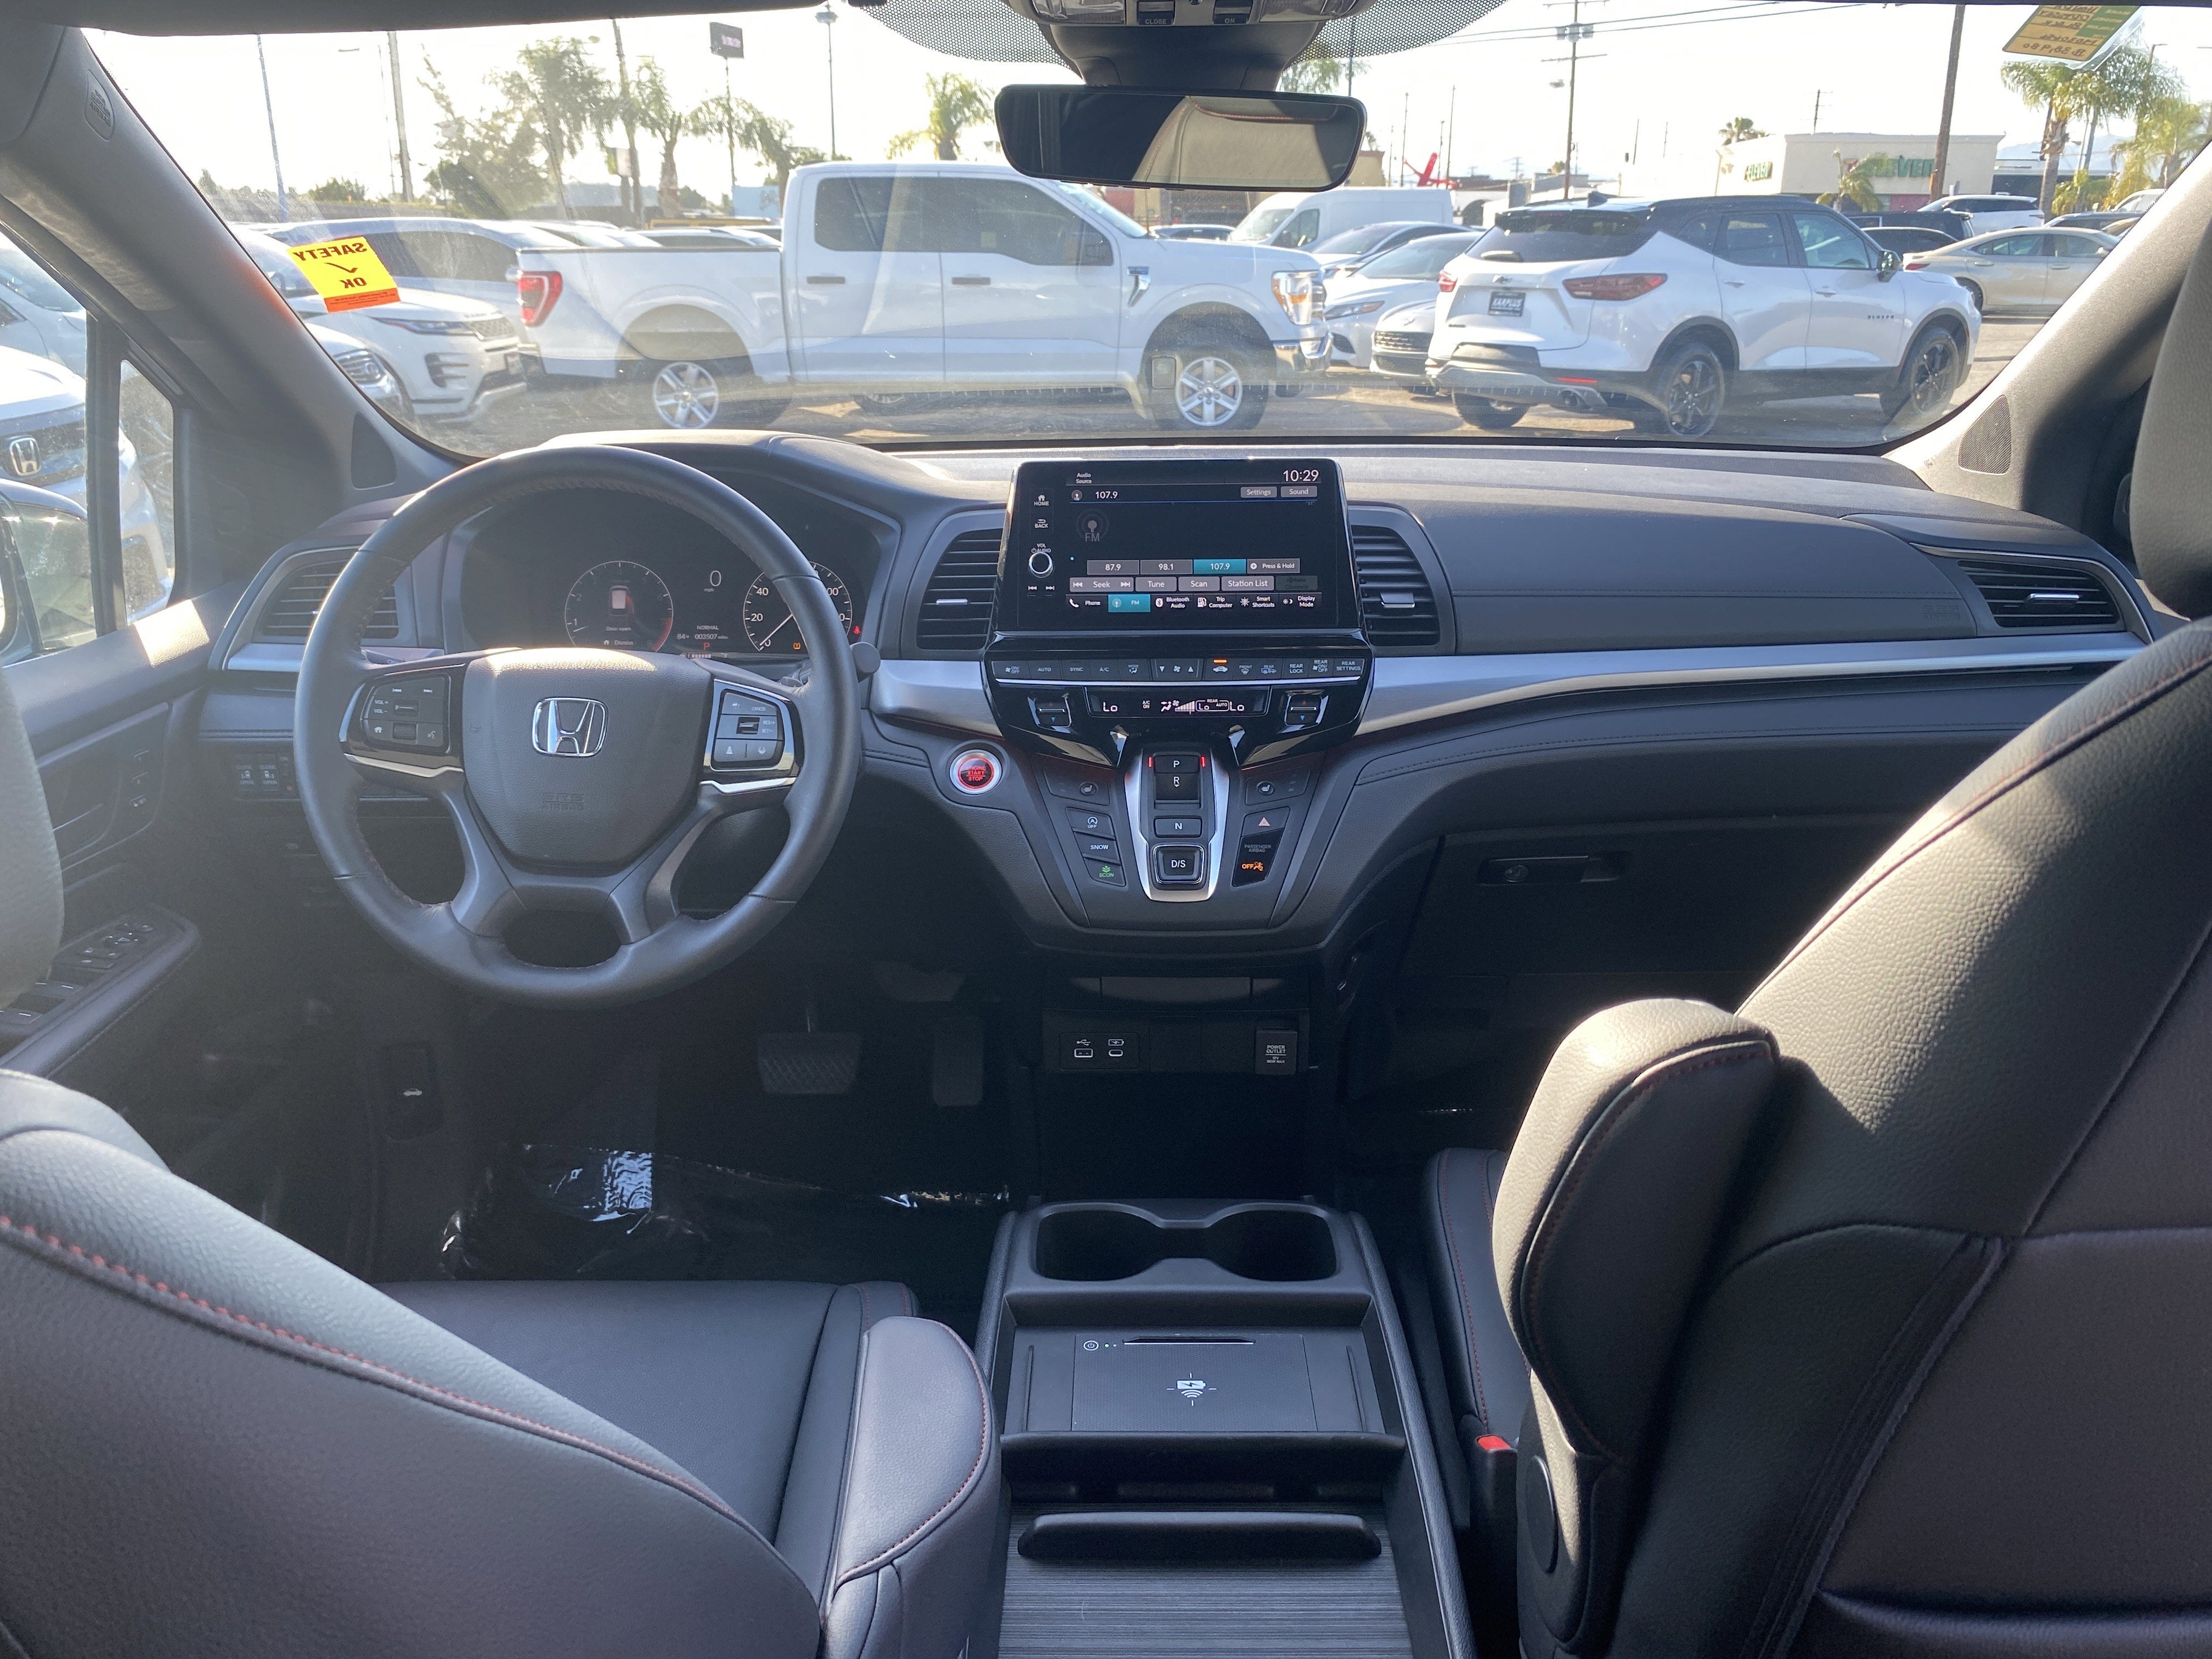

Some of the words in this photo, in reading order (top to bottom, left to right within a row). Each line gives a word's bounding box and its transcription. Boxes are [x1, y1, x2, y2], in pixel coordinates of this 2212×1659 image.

[1283, 469, 1319, 482] 10:29
[1095, 491, 1118, 499] 107.9
[1085, 533, 1101, 542] FM
[709, 569, 722, 587] 0
[756, 587, 769, 596] 40
[825, 588, 839, 596] 00
[751, 613, 763, 622] 20
[704, 642, 710, 651] P
[1173, 776, 1180, 785] R
[1171, 859, 1186, 868] D/S
